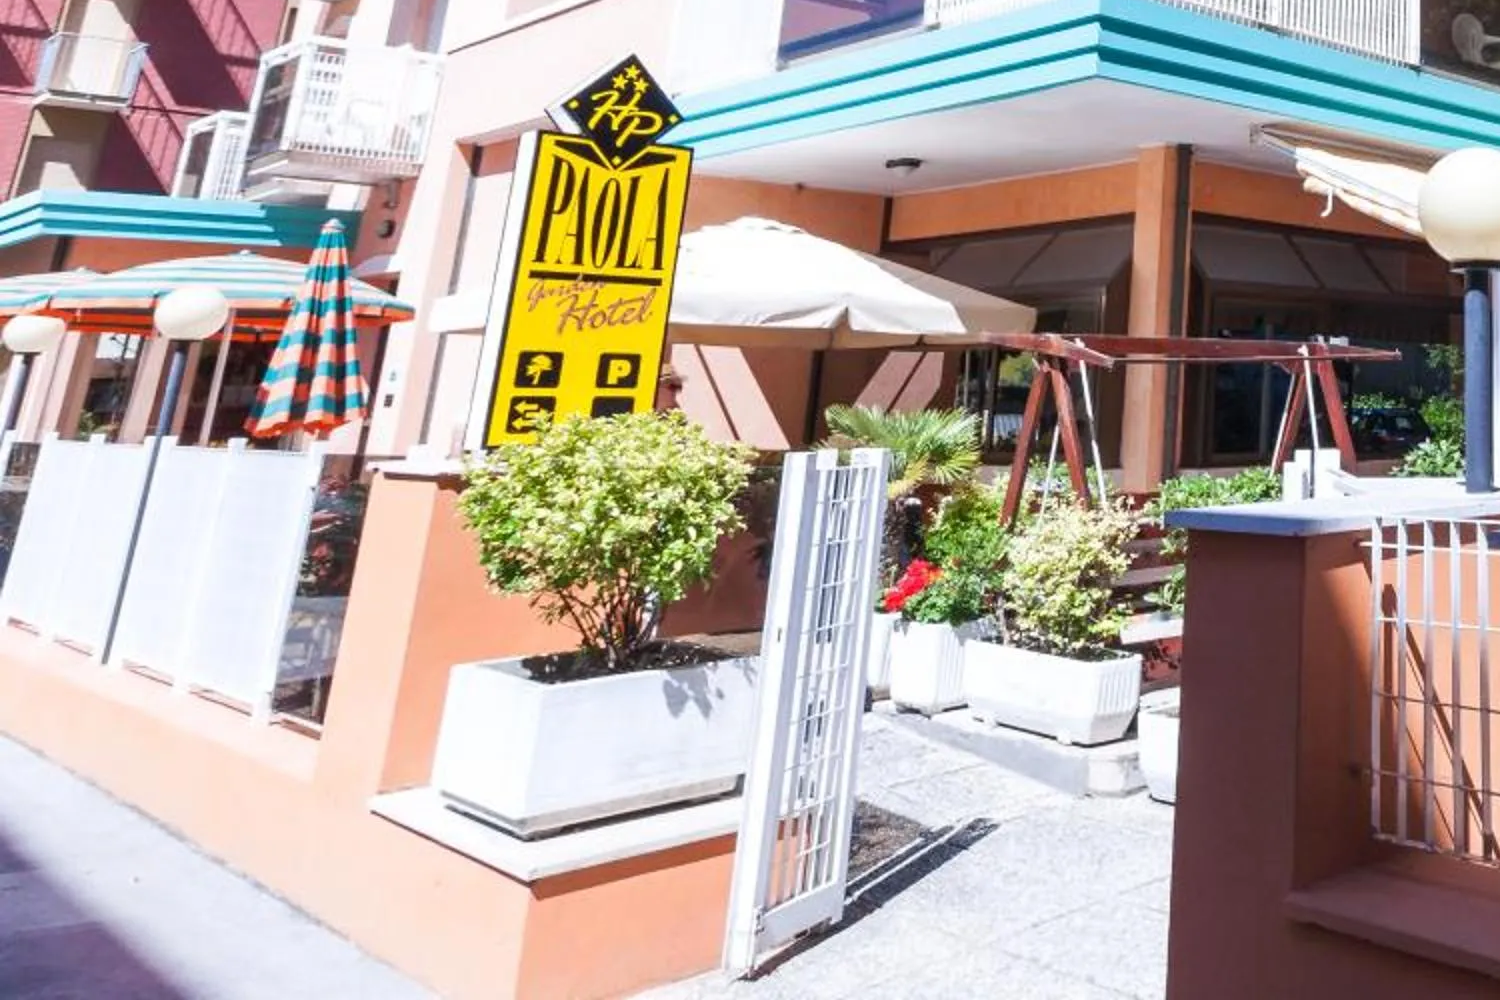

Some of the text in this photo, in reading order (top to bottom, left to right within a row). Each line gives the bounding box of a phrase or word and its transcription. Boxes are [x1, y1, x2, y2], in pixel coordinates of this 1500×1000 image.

[532, 155, 670, 271] PAOLA
[556, 286, 656, 335] Hotel
[606, 358, 632, 385] P
